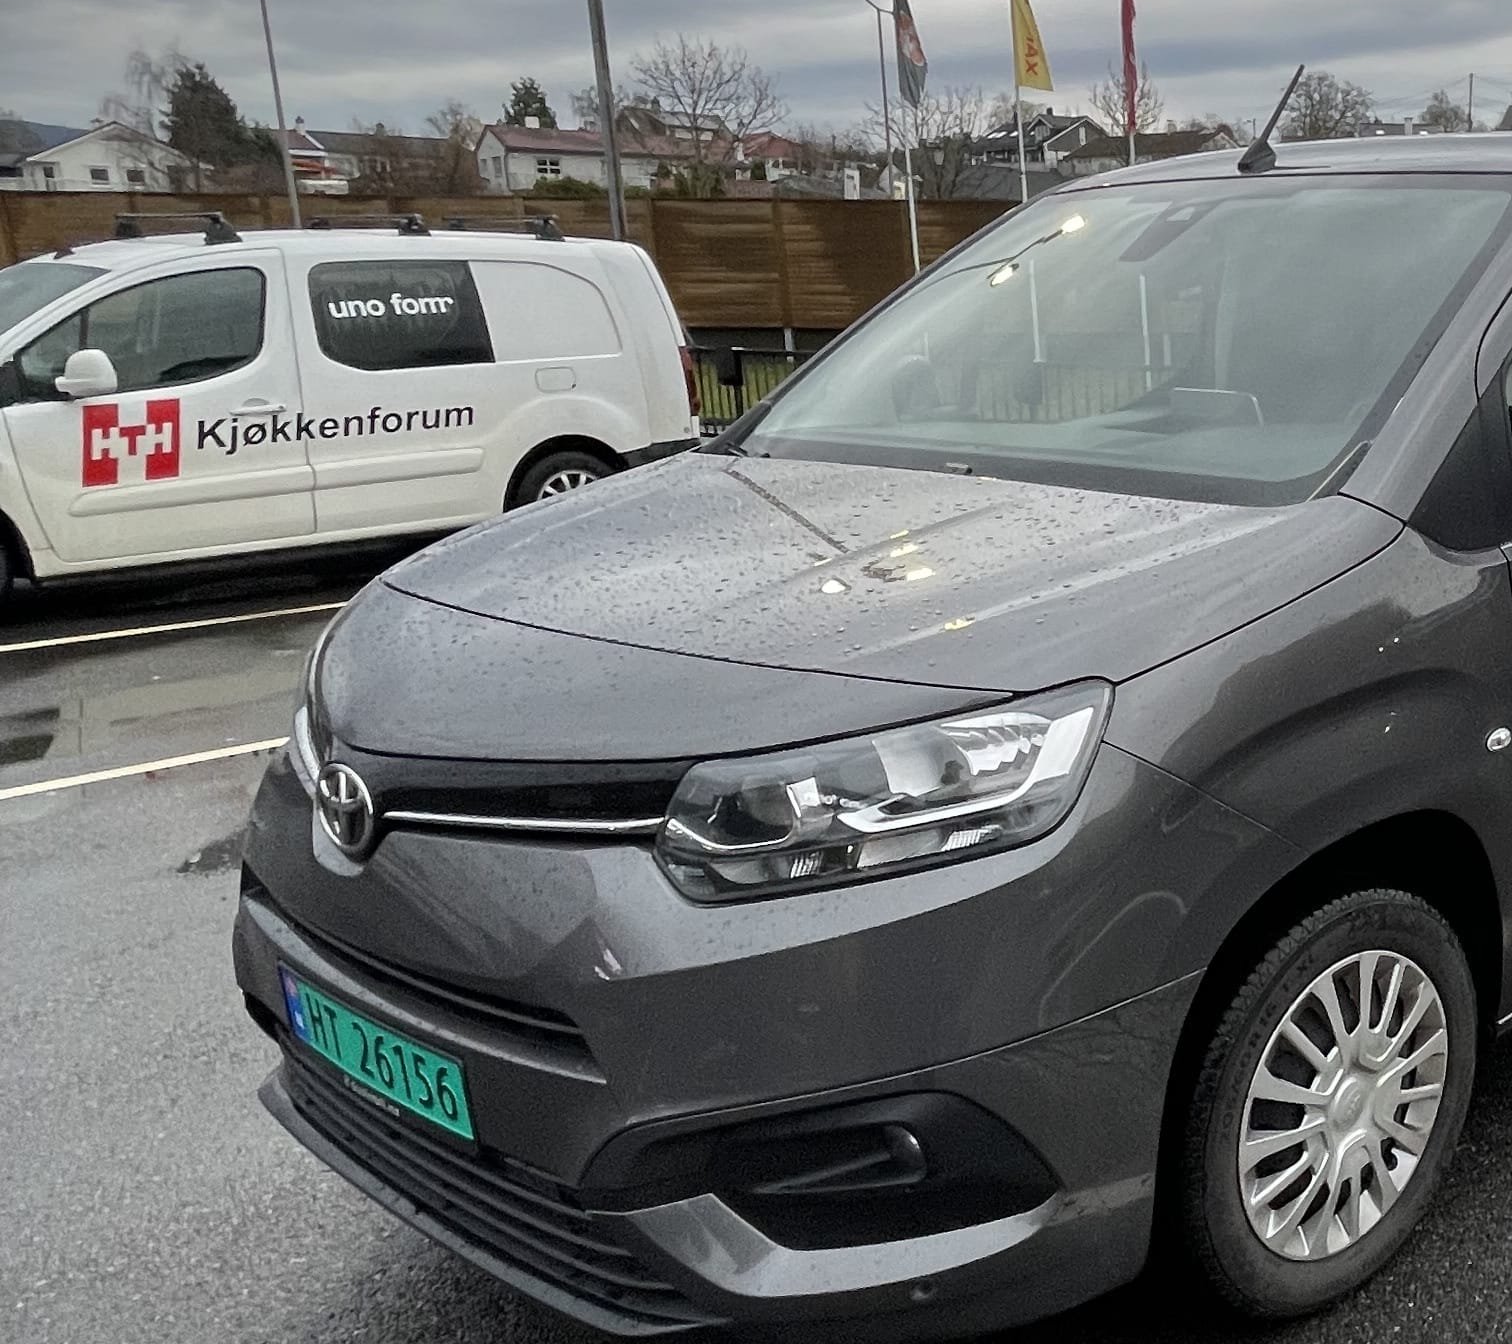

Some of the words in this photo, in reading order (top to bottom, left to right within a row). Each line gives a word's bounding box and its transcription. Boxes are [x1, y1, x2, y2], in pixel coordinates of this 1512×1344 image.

[328, 299, 386, 318] uno
[390, 292, 454, 315] form
[195, 405, 475, 456] Kjøkkenforum
[305, 992, 342, 1061] HT
[352, 1021, 459, 1122] 26156
